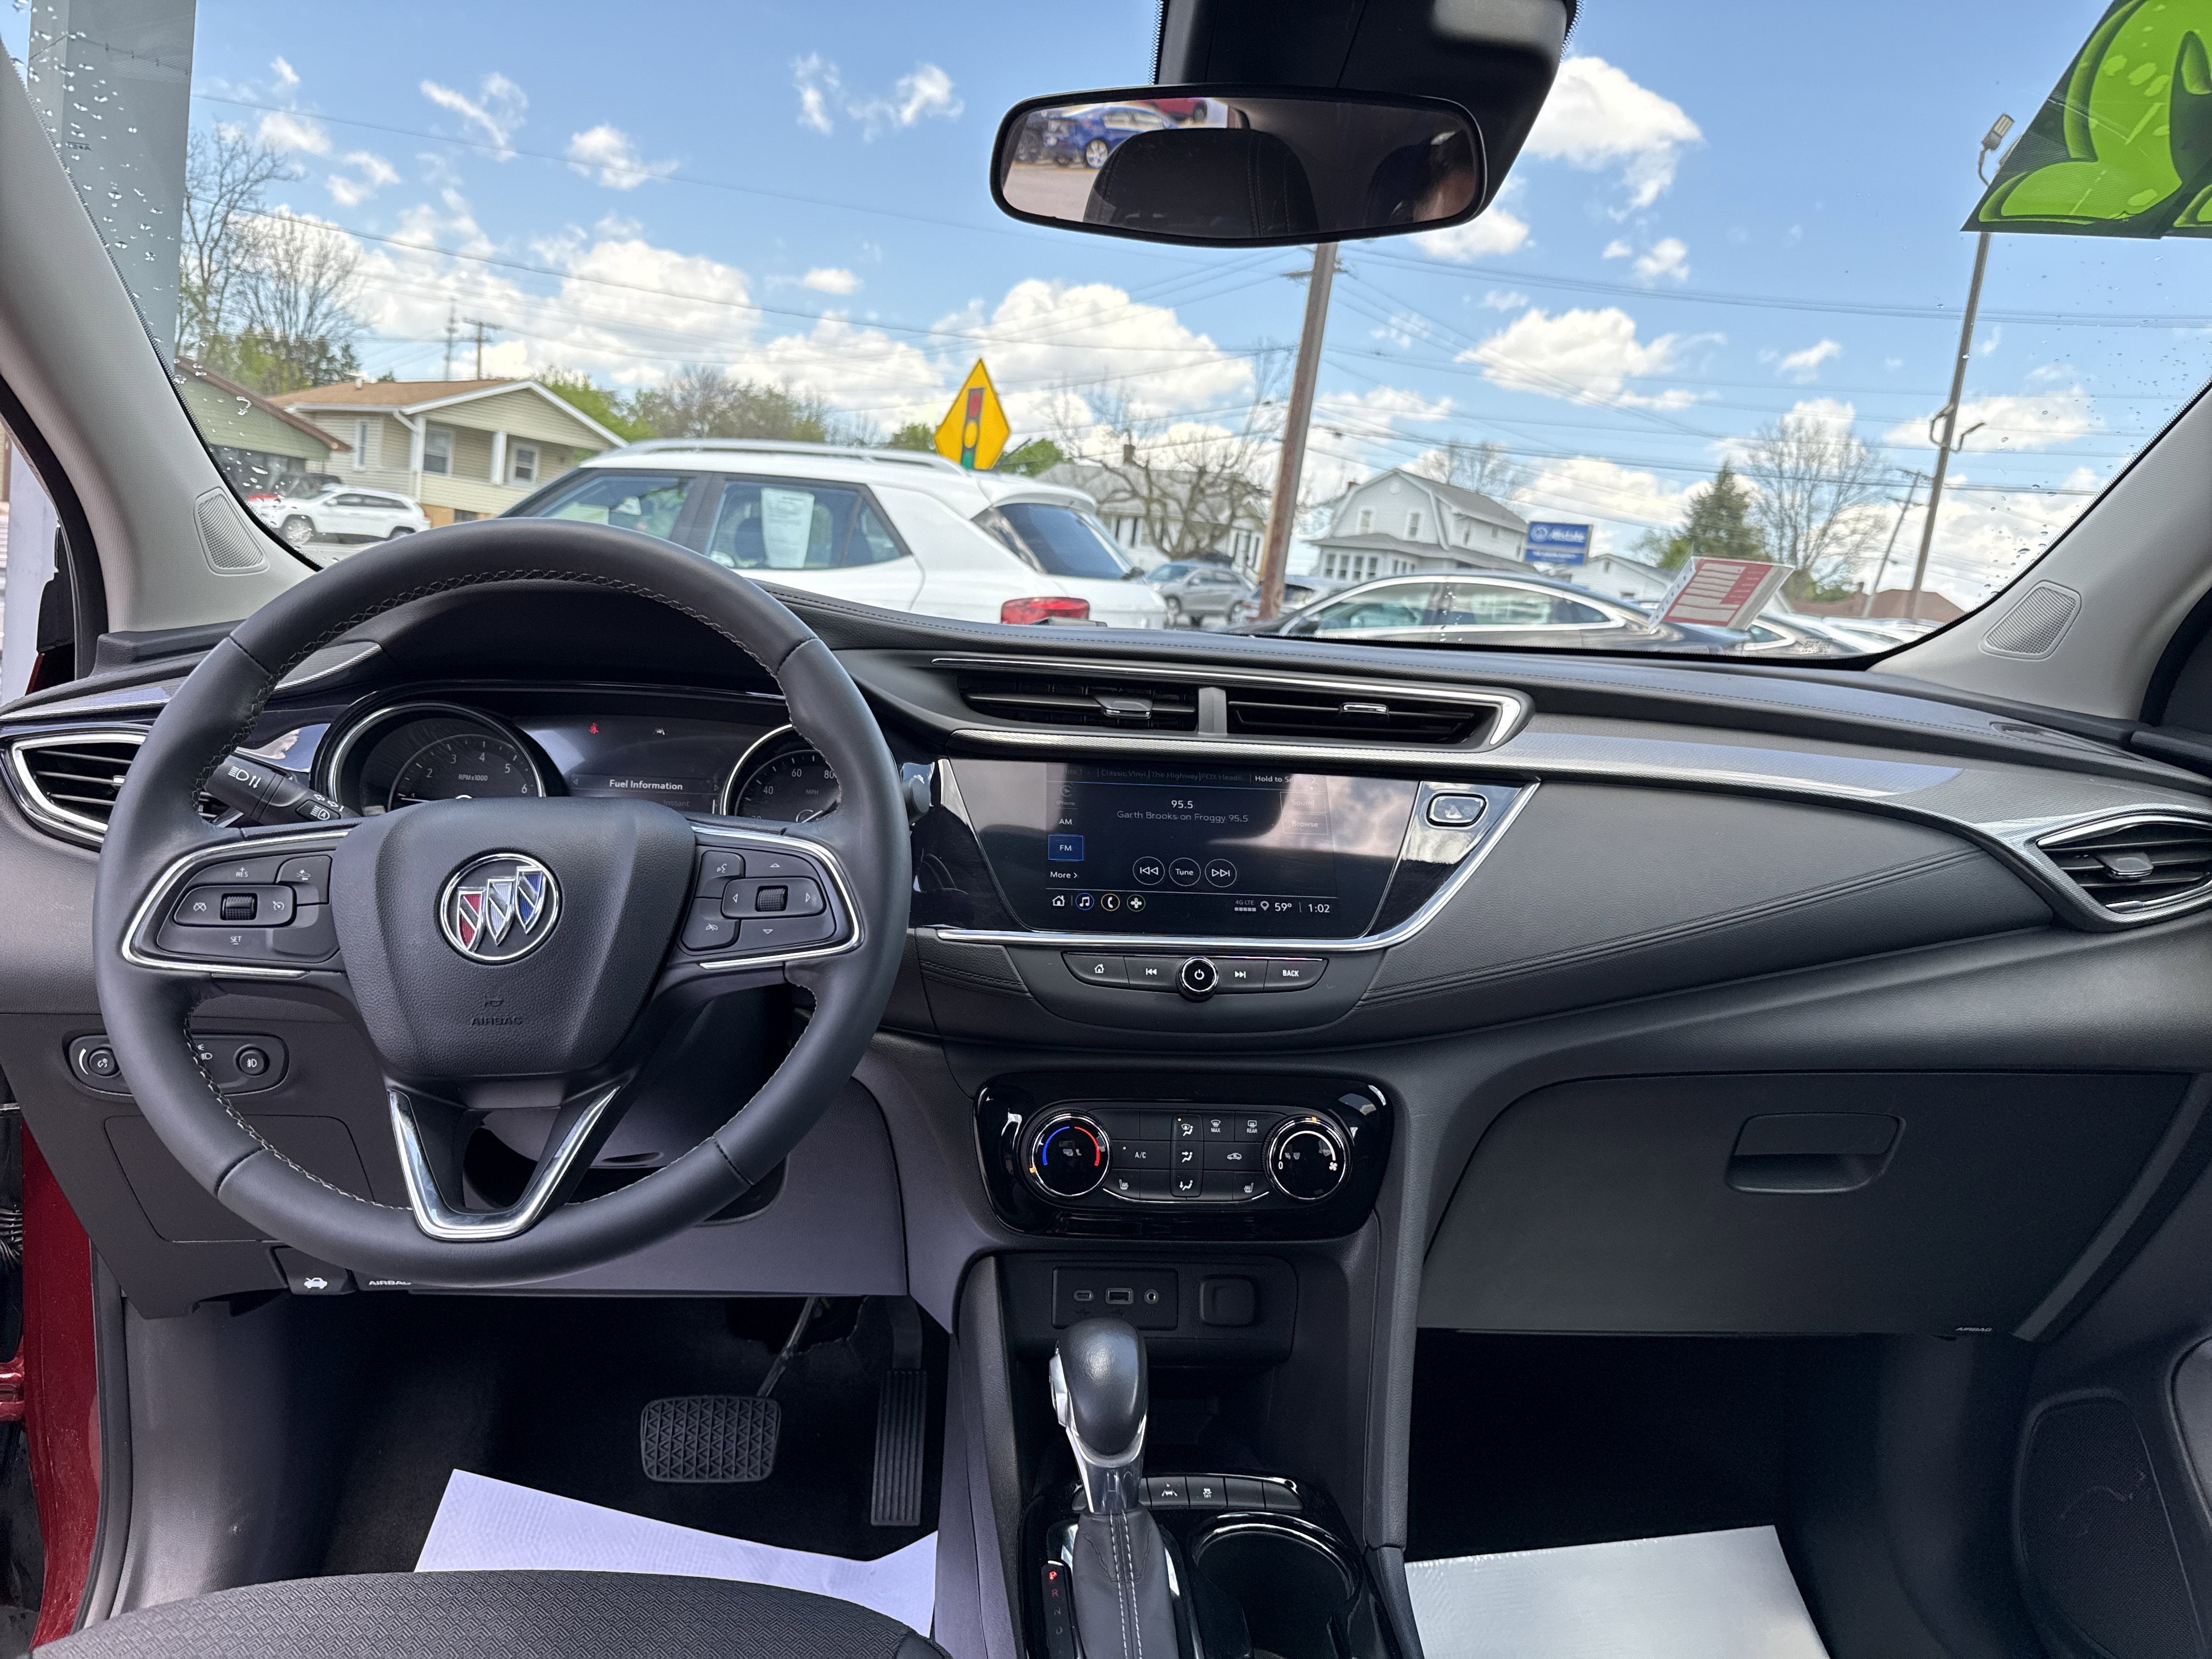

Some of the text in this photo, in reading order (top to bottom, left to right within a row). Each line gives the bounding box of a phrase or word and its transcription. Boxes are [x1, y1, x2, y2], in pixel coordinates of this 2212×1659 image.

[450, 754, 456, 764] 3
[479, 752, 485, 761] 4
[505, 763, 510, 773] 5
[791, 768, 802, 777] 60
[426, 769, 433, 778] 2
[824, 770, 834, 779] 80
[1101, 769, 1146, 778] Classic Vinyl
[1166, 772, 1199, 781] Highway
[521, 783, 527, 794] 6
[609, 779, 683, 790] Fuel Information
[763, 786, 774, 795] 40
[664, 799, 690, 807] Instant
[1171, 799, 1194, 809] 95.5
[1116, 811, 1143, 819] Garth
[1146, 811, 1177, 821] Brooks
[1194, 813, 1226, 823] Froggy
[1228, 814, 1248, 822] 95.5
[1308, 904, 1330, 913] 1:02
[471, 1017, 523, 1026] AIRBAG
[1278, 1161, 1284, 1170] 0
[1049, 1571, 1058, 1580] P
[1051, 1588, 1059, 1597] R
[1054, 1606, 1061, 1616] N
